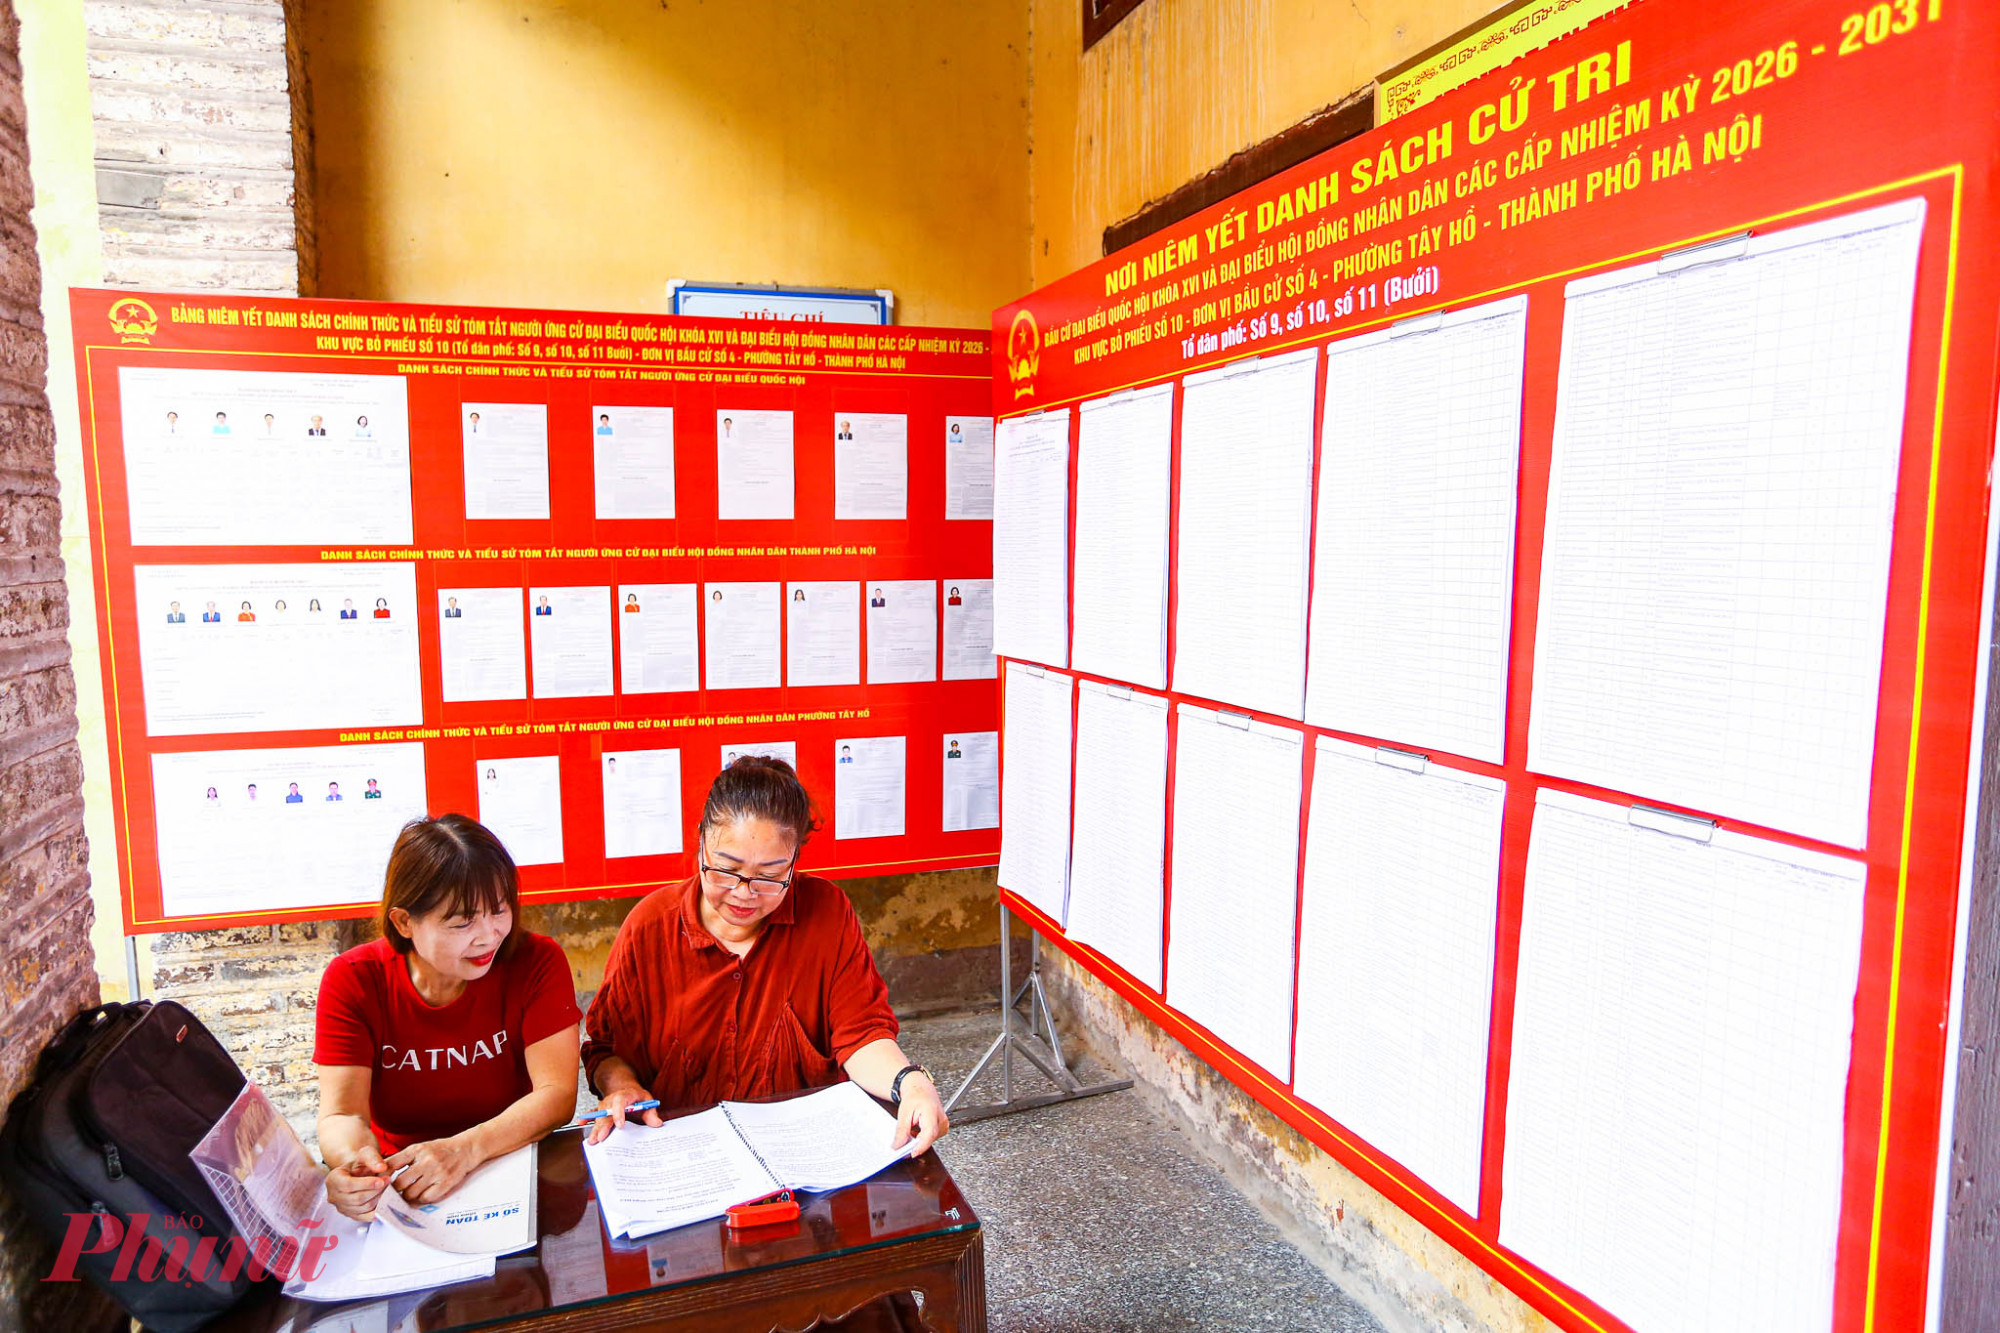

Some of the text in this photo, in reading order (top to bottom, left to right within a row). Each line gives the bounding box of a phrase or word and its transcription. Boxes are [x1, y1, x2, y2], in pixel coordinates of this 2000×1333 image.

[1075, 113, 1762, 364] KHU VỰC BỎ PHIẾU SỐ 10 ĐƠN VỊ BẦU CỬ SỐ 4 PHƯỜNG TÂY HỒ THÀNH PHỐ HÀ NỘI
[1106, 262, 1136, 296] NƠI
[1144, 234, 1197, 281] NIÊM
[1206, 207, 1247, 254] YẾT
[1258, 172, 1338, 233] DANH
[1351, 121, 1452, 193] SÁCH
[1469, 76, 1531, 144] CỬ
[1547, 40, 1630, 112] TRI
[1134, 292, 1150, 316] HỘI
[1152, 281, 1179, 309] KHÓA
[1182, 274, 1199, 297] XVI
[1202, 264, 1217, 290] VÀ
[1220, 258, 1240, 284] ĐẠI
[1244, 239, 1273, 274] BIỂU
[1278, 232, 1301, 263] HỘI
[1306, 217, 1348, 252] ĐỒNG
[1354, 196, 1402, 235] NHÂN
[1409, 178, 1448, 216] DÂN
[1455, 160, 1497, 197] CÁC
[1505, 132, 1552, 180] CẤP
[1561, 99, 1650, 159] NHIỆM
[1661, 74, 1701, 123] KỲ
[1711, 41, 1798, 104] 2026
[1181, 265, 1439, 360] Tổ dân phố: Số 9, số 10, số 11 (Bưởi)
[382, 1029, 508, 1071] CATNAP
